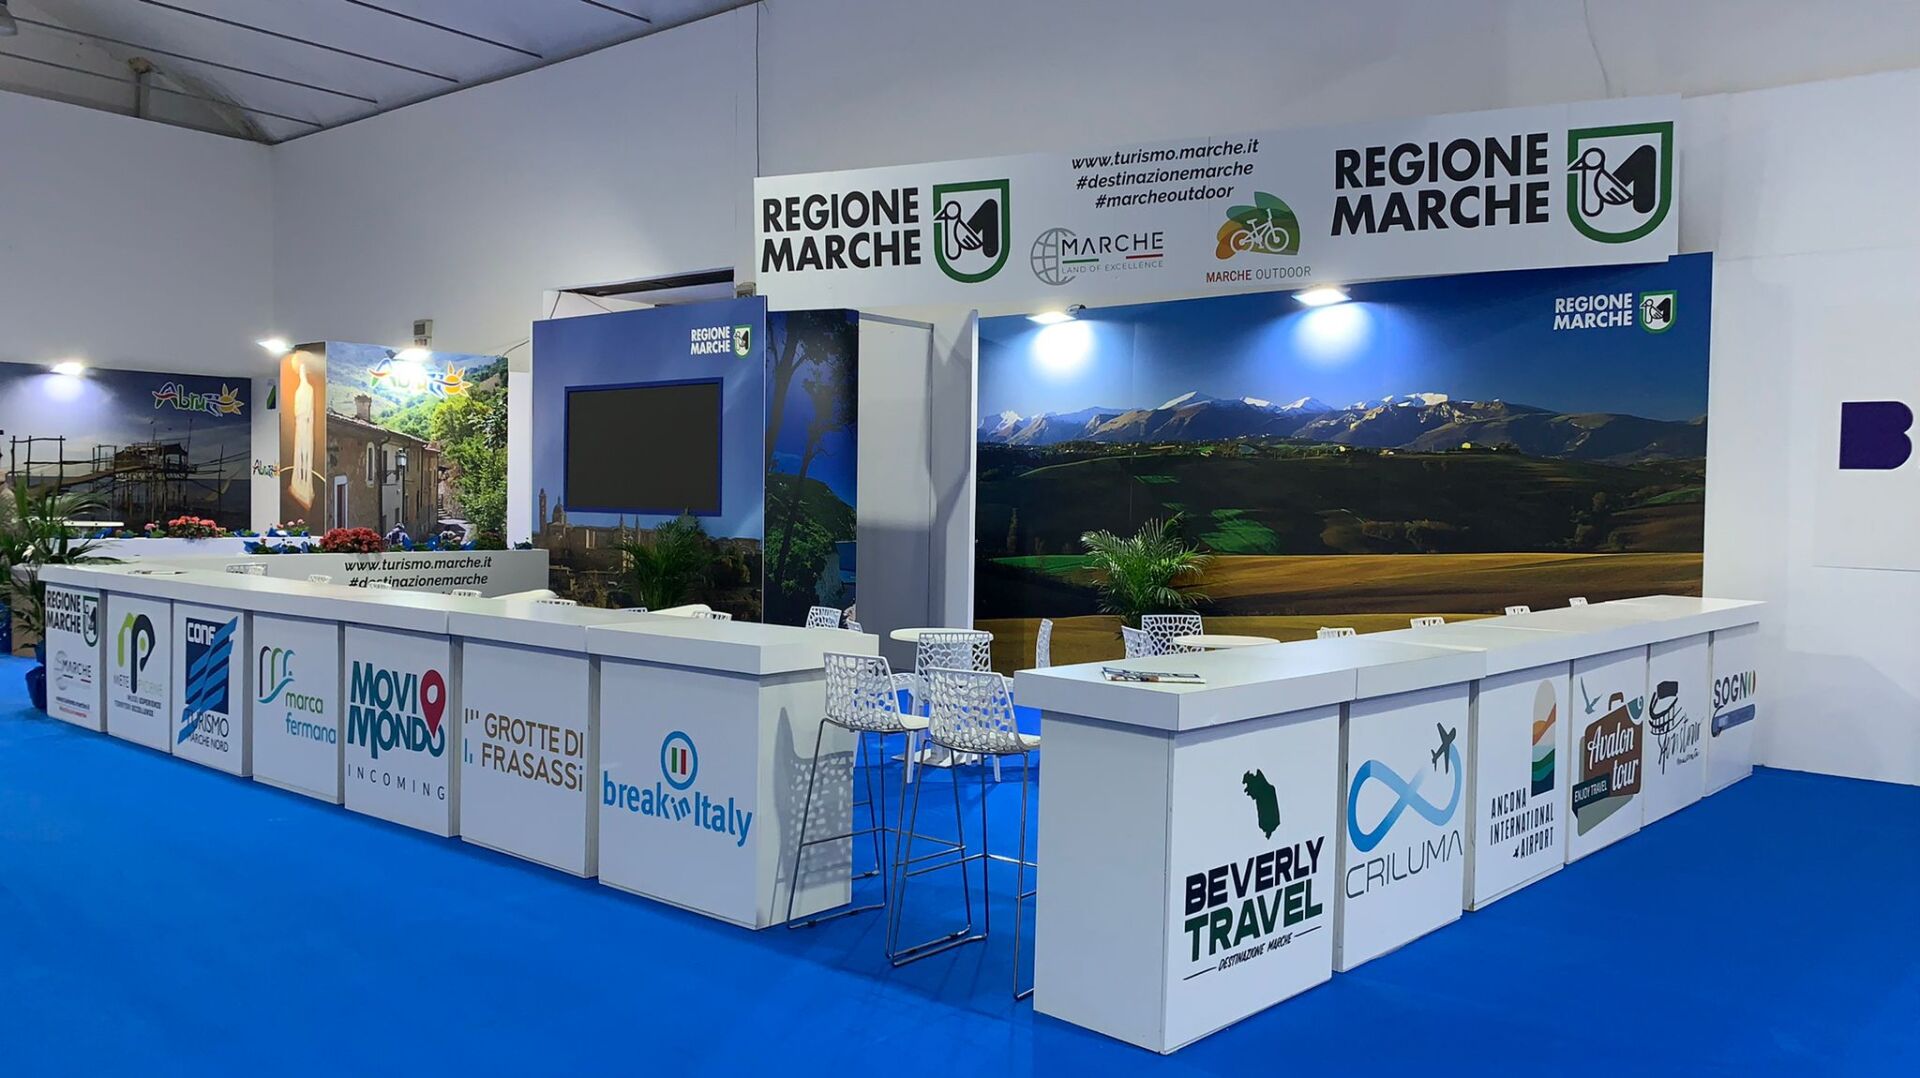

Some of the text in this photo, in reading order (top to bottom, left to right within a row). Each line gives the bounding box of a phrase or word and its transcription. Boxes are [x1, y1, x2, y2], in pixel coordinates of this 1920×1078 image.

[1071, 138, 1260, 171] www.turismo.marche.it
[1335, 132, 1549, 190] REGIONE
[1075, 161, 1254, 191] #destinazionemarche
[763, 187, 919, 233] REGIONE
[1094, 184, 1235, 210] #marcheoutdoor
[1330, 181, 1550, 237] MARCHE
[761, 229, 922, 273] MARCHE
[1062, 231, 1165, 257] MARCHE
[1062, 264, 1087, 275] LAND
[1205, 265, 1312, 284] MARCHE OUTDOOR
[1555, 292, 1633, 314] REGIONE
[691, 325, 731, 342] REGIONE
[1553, 310, 1633, 331] MARCHE
[690, 339, 731, 356] MARCHE
[344, 555, 493, 572] www.turismo.marche.it
[46, 590, 82, 614] REGIONE
[46, 610, 82, 635] MARCHE
[285, 692, 324, 714] marca
[350, 660, 418, 715] MOVI
[285, 711, 337, 745] fermana
[484, 712, 584, 759] GROTTE DI
[1587, 722, 1634, 770] Avalon
[348, 763, 446, 801] INCOMING
[1574, 779, 1608, 803] ENJOY TRAVEL
[1612, 759, 1639, 791] tour
[1491, 787, 1527, 819] ANCONA
[1490, 802, 1554, 846] INTERNATIONAL
[1520, 826, 1554, 859] AIRPORT
[1185, 836, 1325, 916] BEVERLY
[1346, 829, 1463, 899] CRILUMA
[1184, 878, 1323, 963] TRAVEL
[1218, 932, 1293, 972] DESTINAZIONE MARCHE
